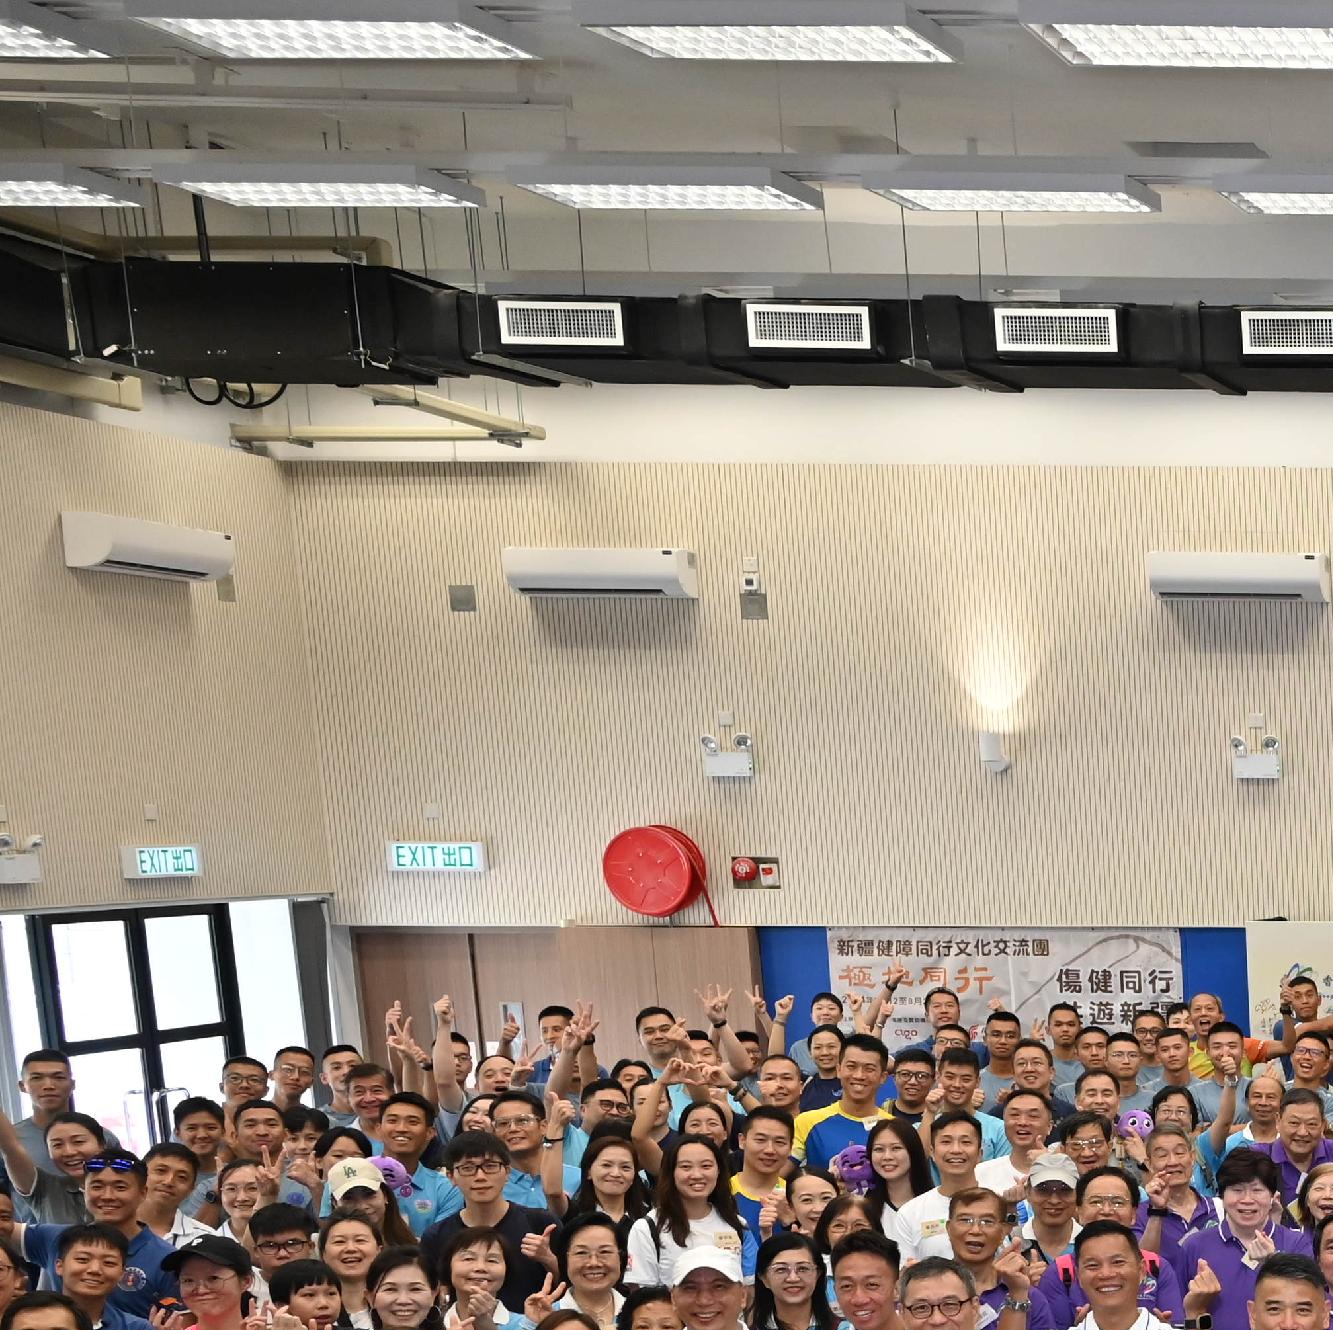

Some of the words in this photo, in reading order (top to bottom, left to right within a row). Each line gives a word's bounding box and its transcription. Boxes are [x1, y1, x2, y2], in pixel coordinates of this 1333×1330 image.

[140, 849, 170, 873] EXIT
[173, 850, 194, 872] 出口
[396, 845, 435, 867] EXIT
[442, 846, 473, 867] 出口
[1057, 968, 1175, 994] 傷健同行
